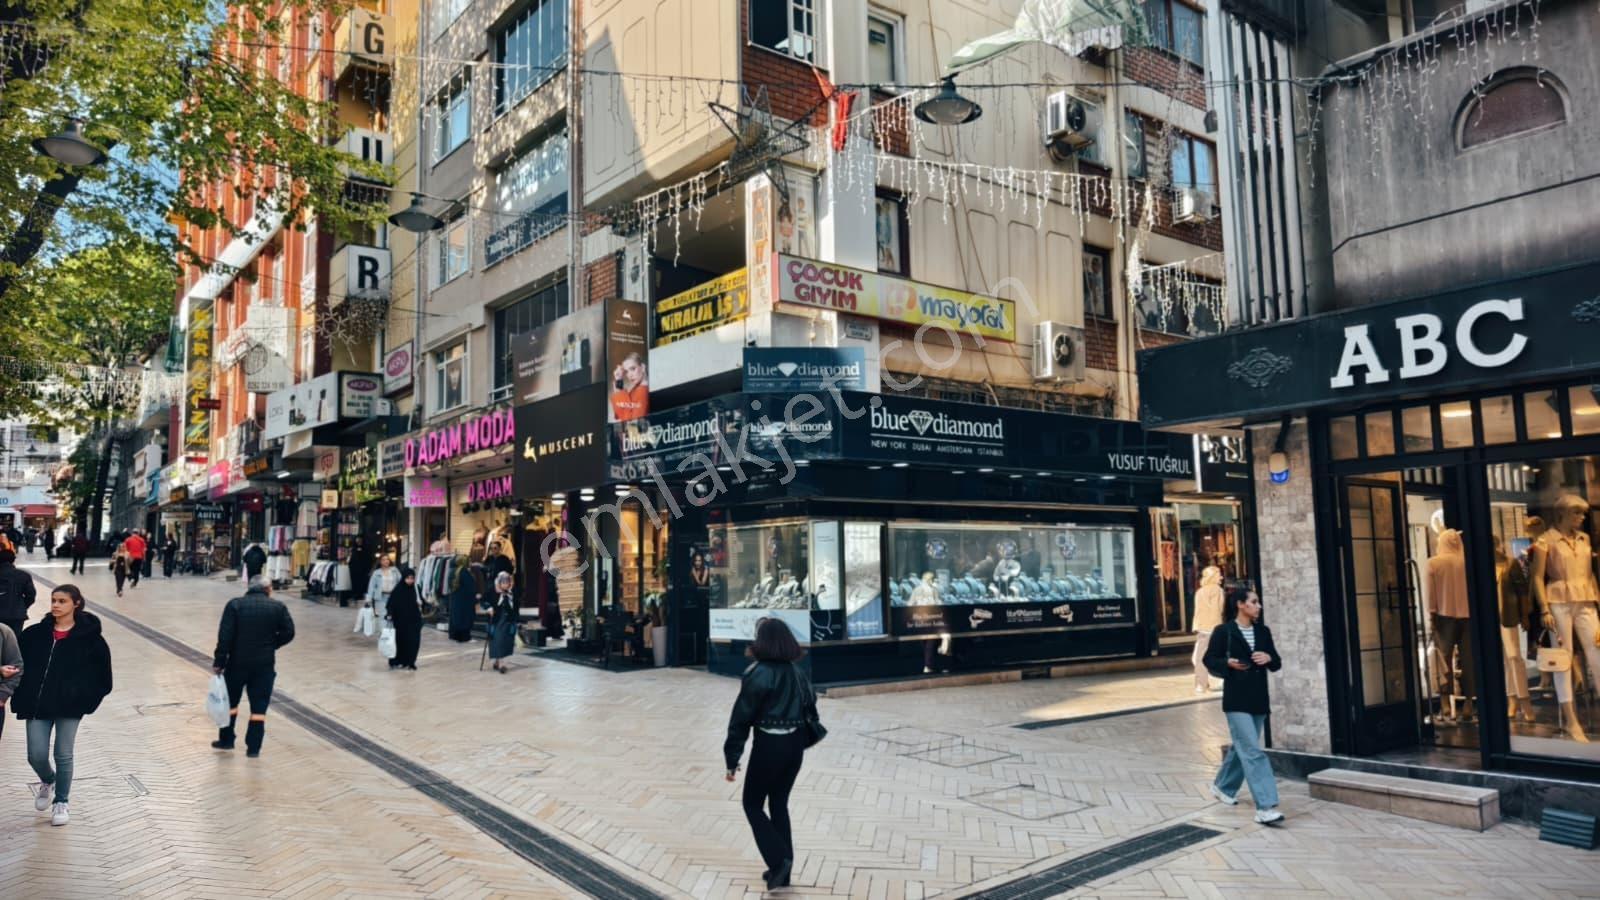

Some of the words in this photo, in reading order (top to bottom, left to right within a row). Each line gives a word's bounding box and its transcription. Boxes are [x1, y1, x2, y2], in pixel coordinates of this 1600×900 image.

[787, 260, 864, 291] ÇOCUK
[919, 295, 1004, 331] mayoral
[1330, 297, 1528, 389] ABC
[747, 361, 777, 377] blue
[797, 361, 860, 377] diamond
[418, 423, 462, 465] ADAM
[465, 406, 515, 453] MODA
[622, 431, 648, 452] blue
[662, 411, 719, 444] diamond
[870, 405, 910, 431] blue
[932, 417, 1004, 439] diamond
[539, 432, 594, 456] MUSCENT
[1107, 452, 1145, 471] YUSUF
[1147, 456, 1192, 475] TUĞRUL
[477, 475, 513, 501] ADAM
